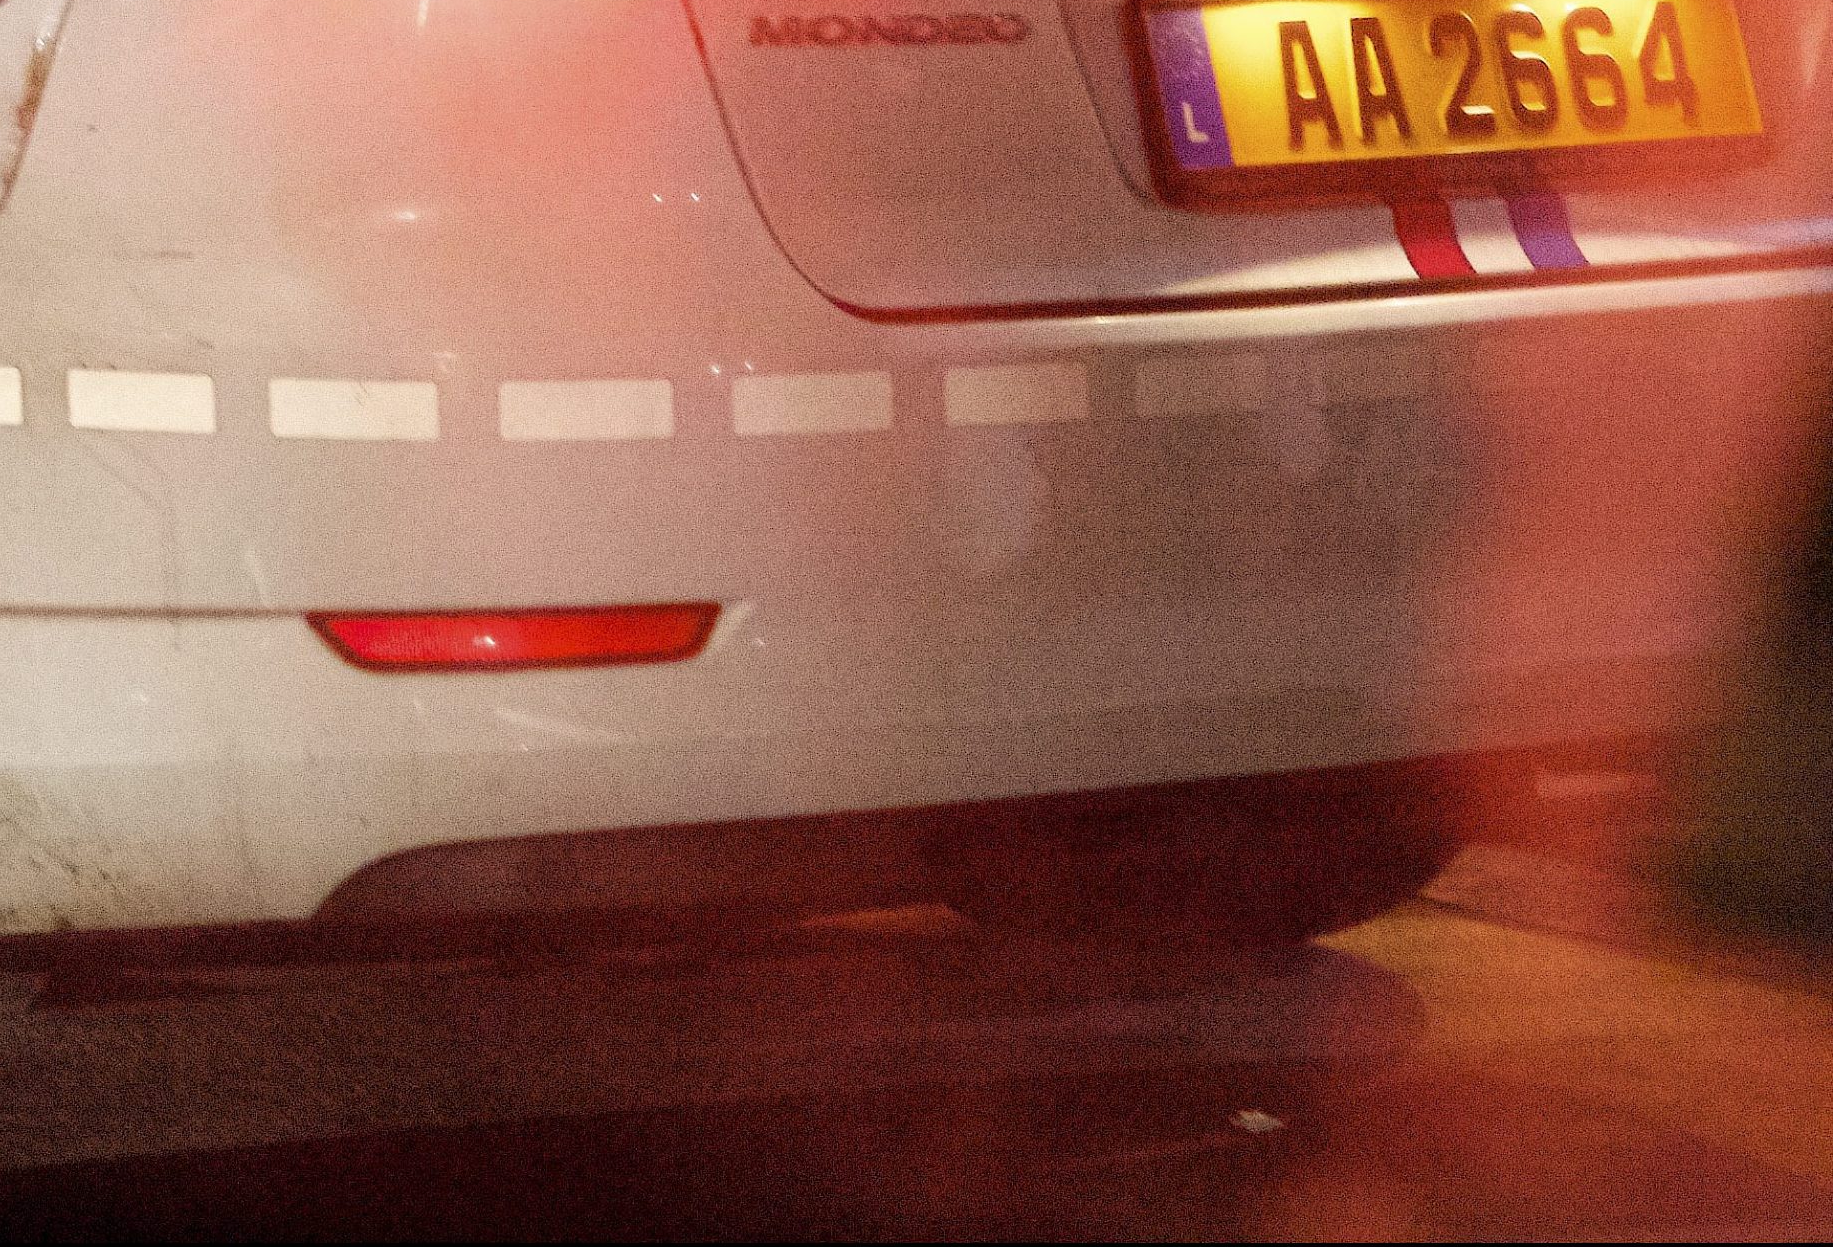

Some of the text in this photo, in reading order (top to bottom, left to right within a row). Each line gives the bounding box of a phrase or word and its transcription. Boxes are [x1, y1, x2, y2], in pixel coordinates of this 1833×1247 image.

[748, 14, 1031, 46] MONDEO
[1279, 0, 1700, 152] AA 2664
[1181, 100, 1210, 144] L
